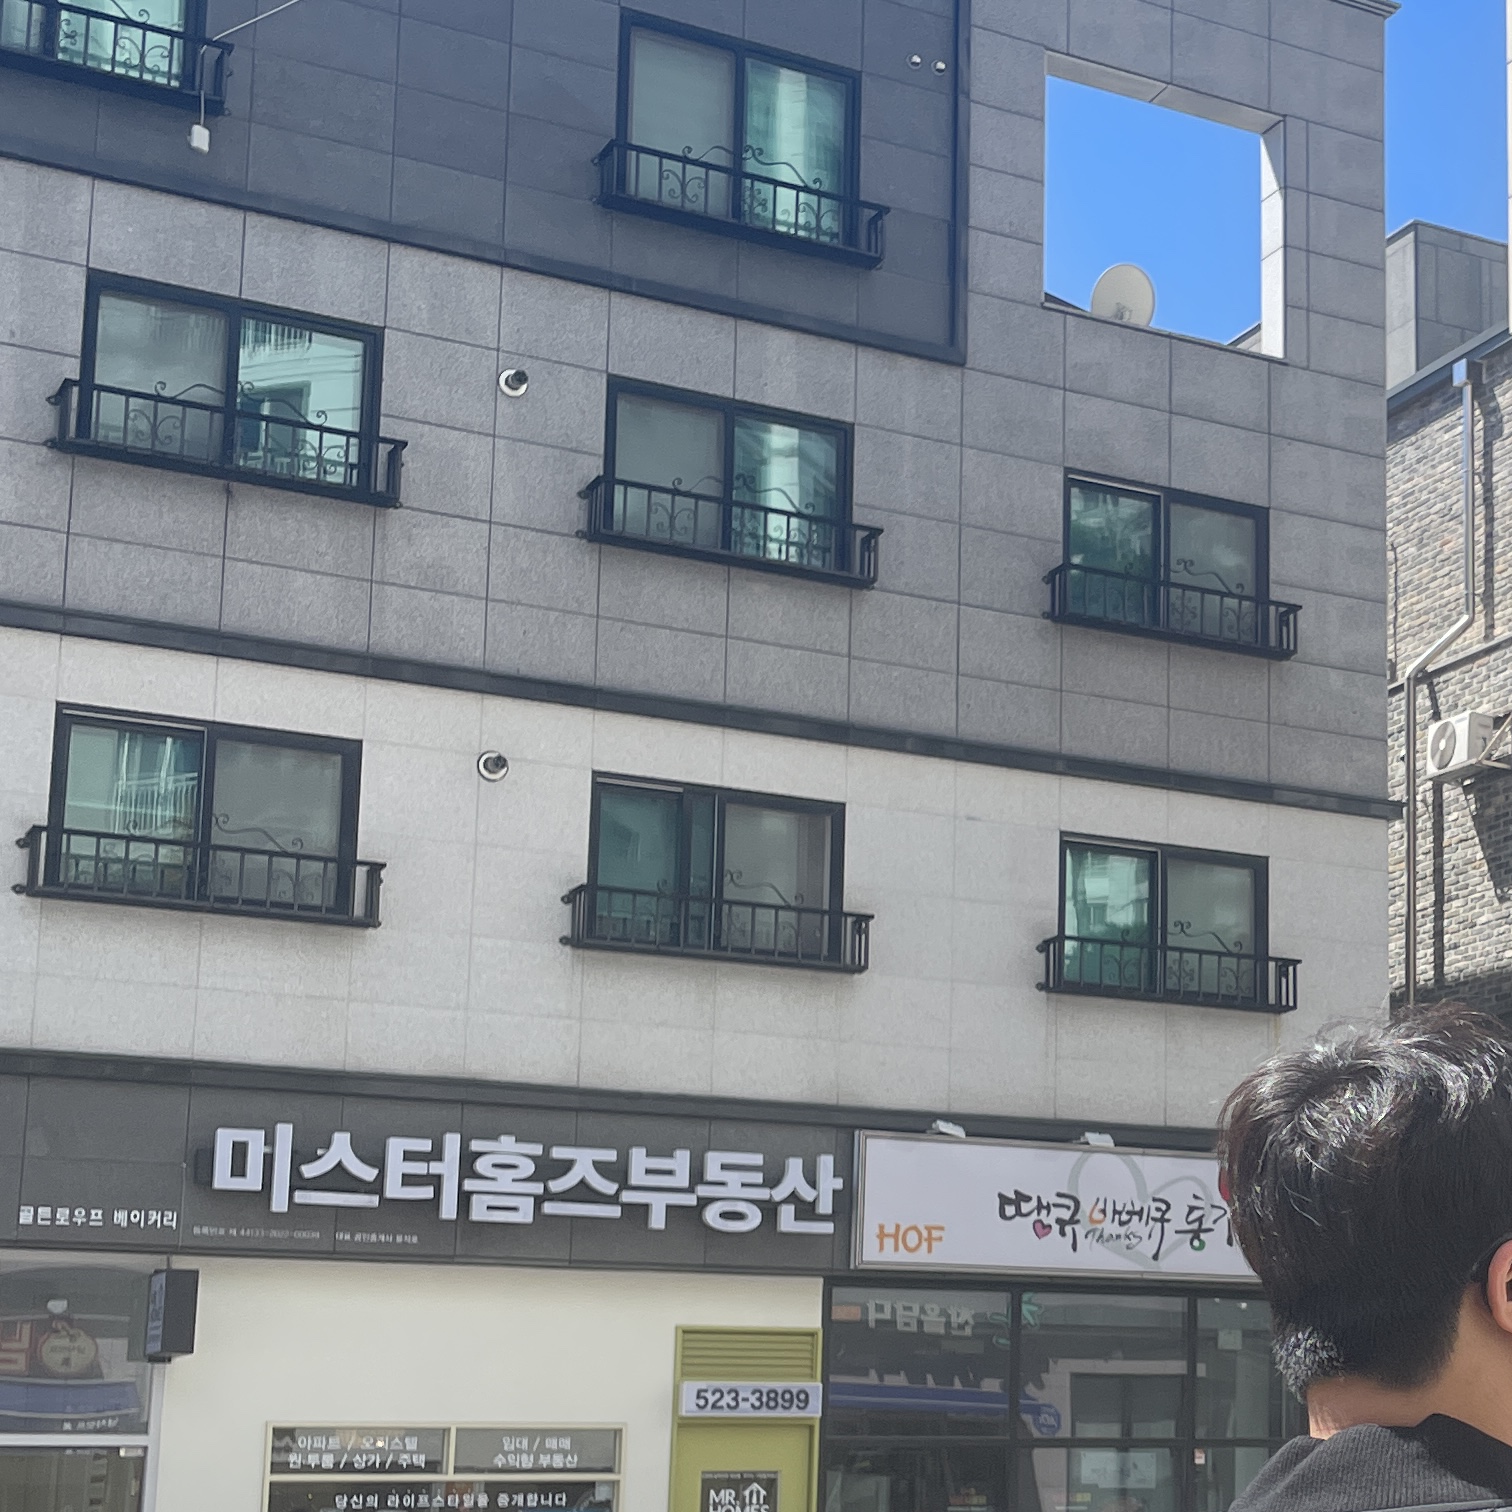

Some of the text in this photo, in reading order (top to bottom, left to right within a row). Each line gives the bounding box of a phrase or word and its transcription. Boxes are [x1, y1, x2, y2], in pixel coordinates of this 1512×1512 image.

[212, 1122, 843, 1233] 미스터홈즈부동산
[113, 1208, 178, 1229] 베이커리
[876, 1223, 945, 1254] HOF
[695, 1388, 810, 1411] 523-3899
[297, 1435, 341, 1451] 아파트
[502, 1436, 529, 1451] 임대
[352, 1453, 381, 1470] 상가
[398, 1453, 426, 1469] 주택
[538, 1453, 578, 1468] 부동산
[335, 1492, 567, 1509] 당신의 라이프스타일을 중개합니다
[709, 1488, 740, 1505] MR.
